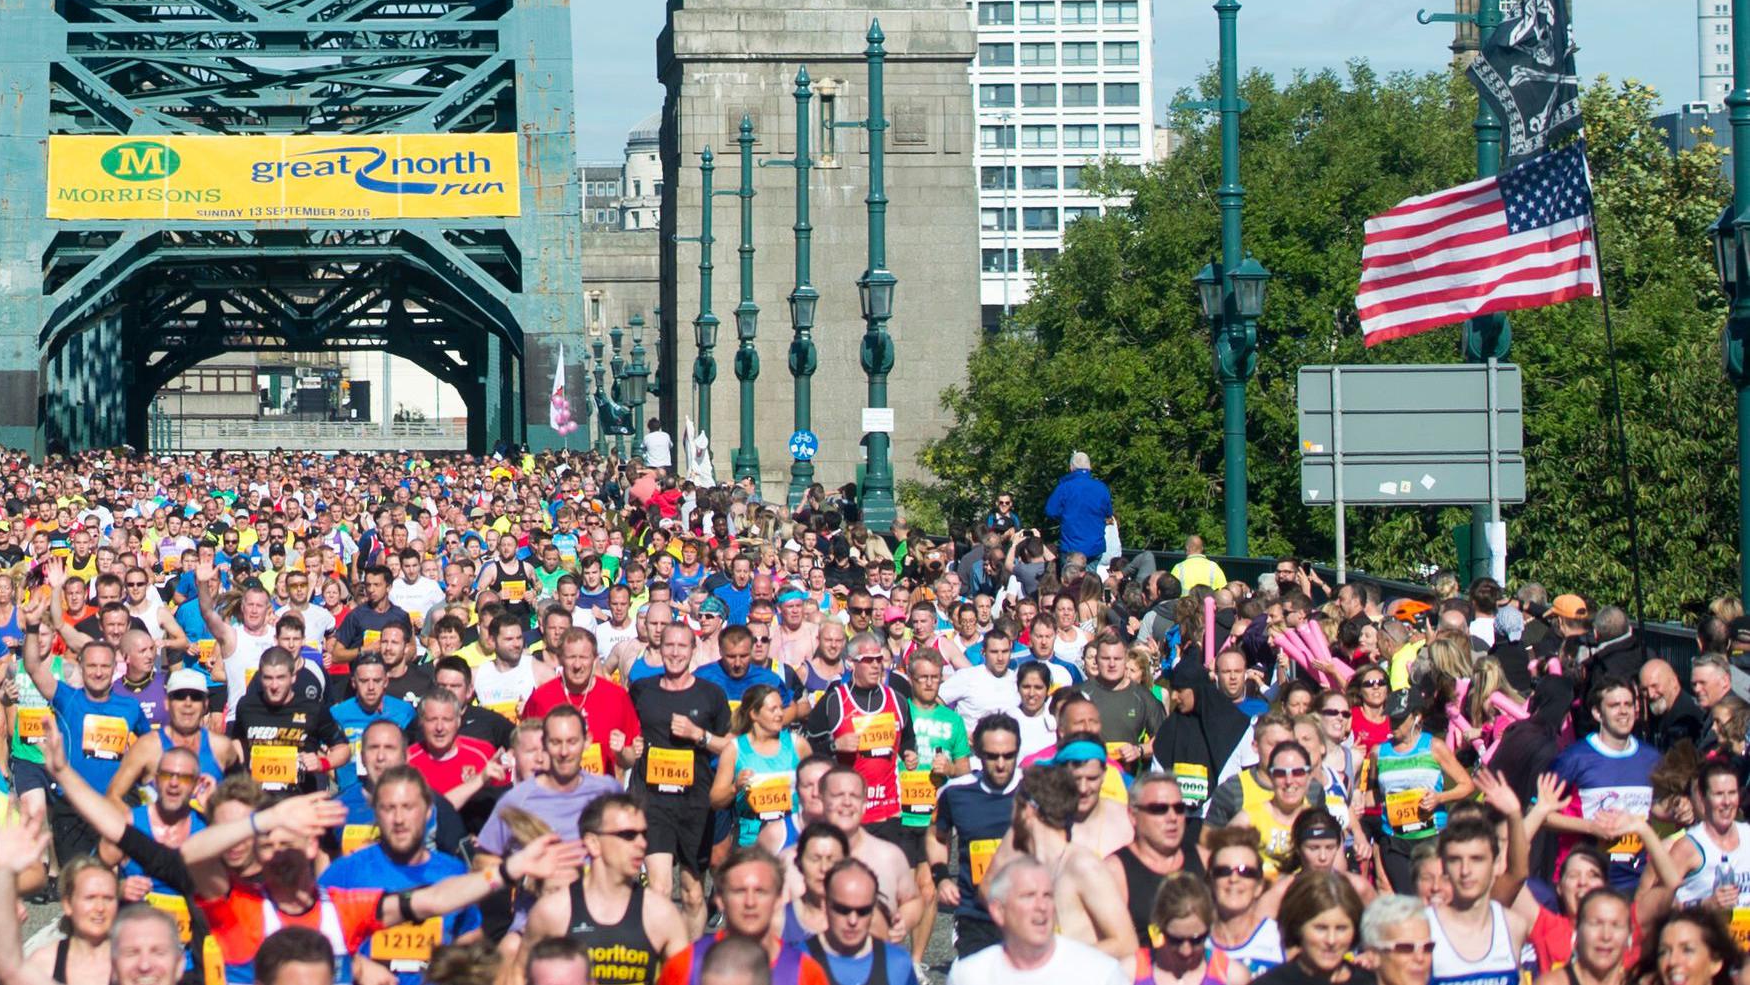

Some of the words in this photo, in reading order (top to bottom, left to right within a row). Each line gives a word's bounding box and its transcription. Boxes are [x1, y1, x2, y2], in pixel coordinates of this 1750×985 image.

[115, 148, 166, 176] M
[250, 152, 352, 183] great
[392, 151, 491, 176] north
[439, 180, 507, 196] run
[57, 187, 222, 203] MORRISONS
[196, 208, 244, 217] SUNDAY
[249, 207, 262, 216] 13
[266, 206, 336, 216] SEPTEMBER
[88, 733, 124, 746] 12477
[862, 731, 895, 743] 13986
[259, 764, 288, 776] 4991
[653, 766, 689, 779] 11846
[752, 793, 787, 805] 13564
